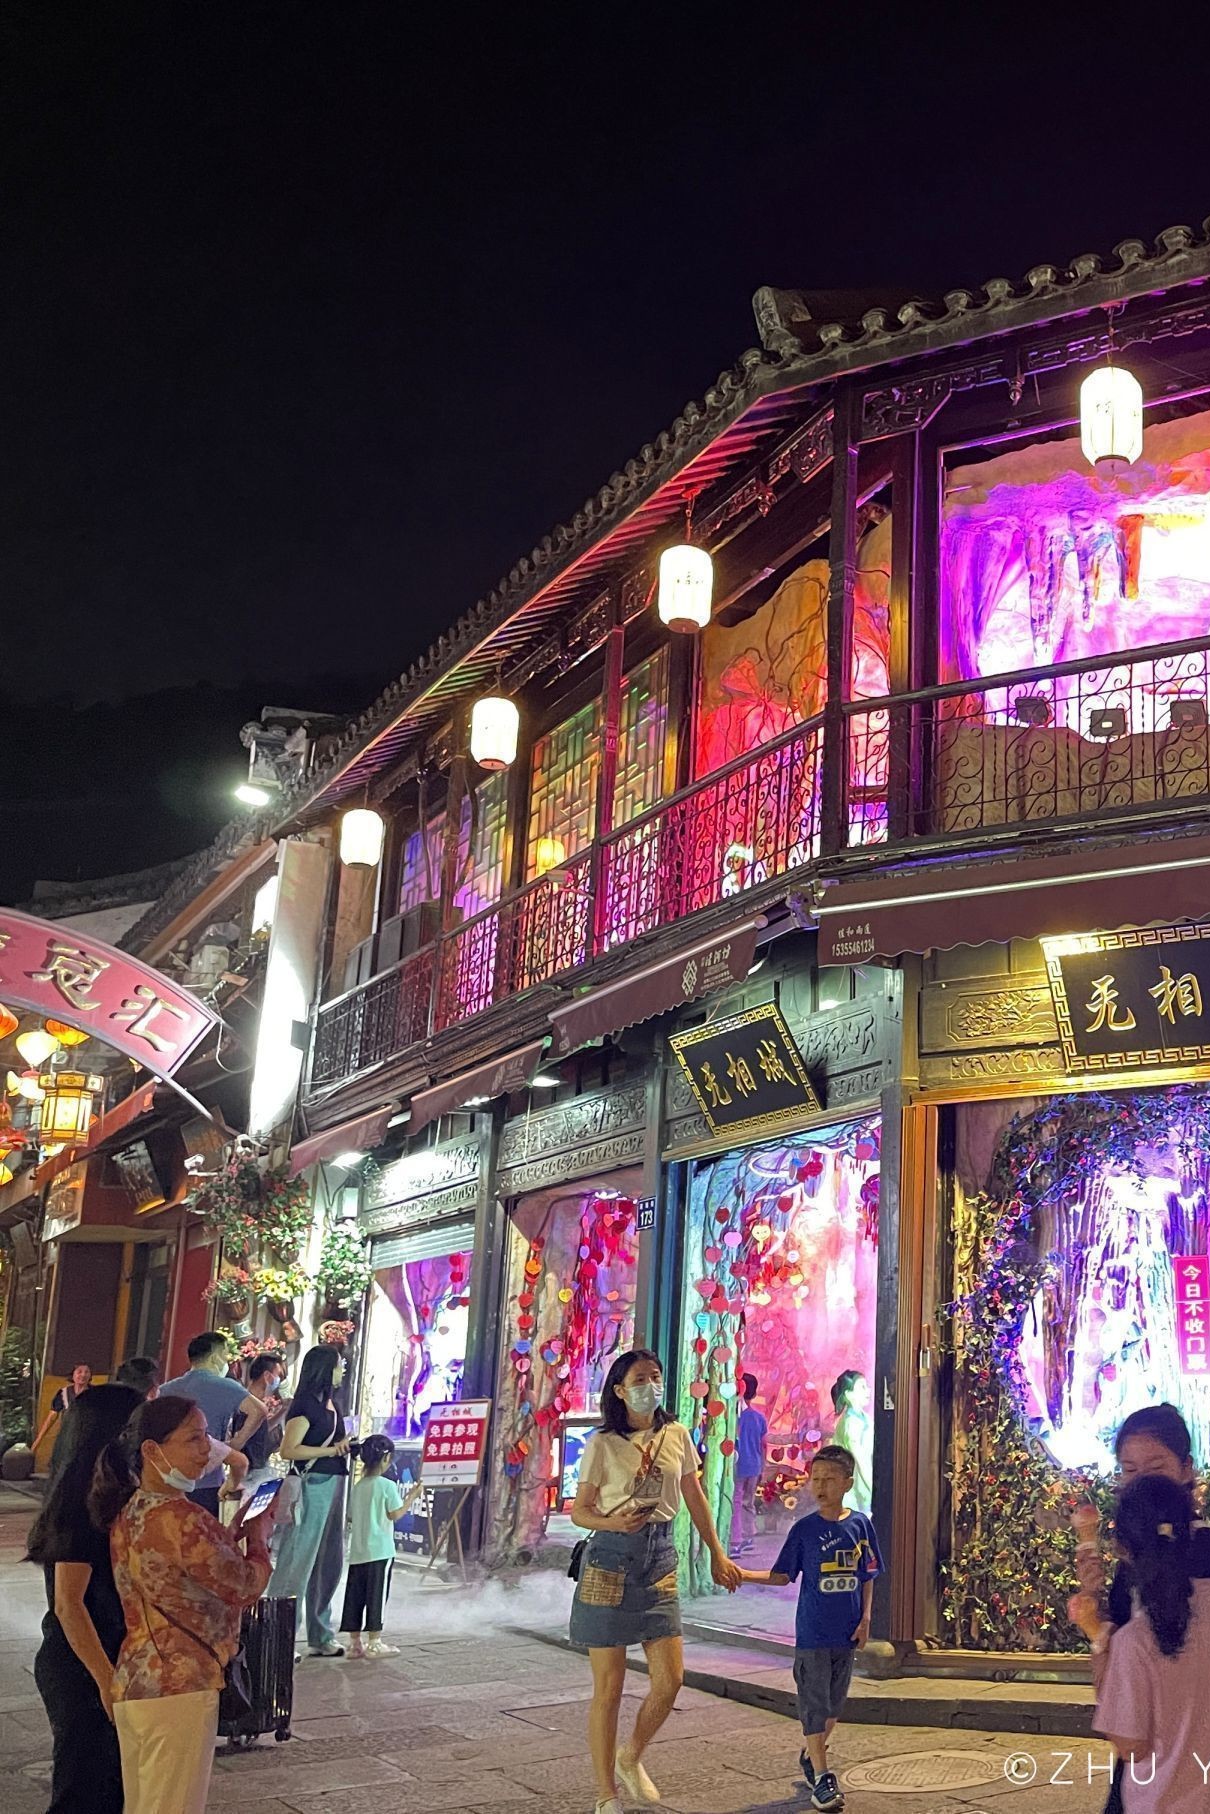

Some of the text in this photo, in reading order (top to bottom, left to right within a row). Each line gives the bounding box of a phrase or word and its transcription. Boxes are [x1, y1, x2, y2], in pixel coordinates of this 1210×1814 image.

[832, 938, 875, 957] 15355461234
[0, 934, 191, 1053] 总汇
[640, 1210, 653, 1226] 173
[429, 1423, 479, 1438] 免费参观
[426, 1441, 476, 1457] 免费拍照
